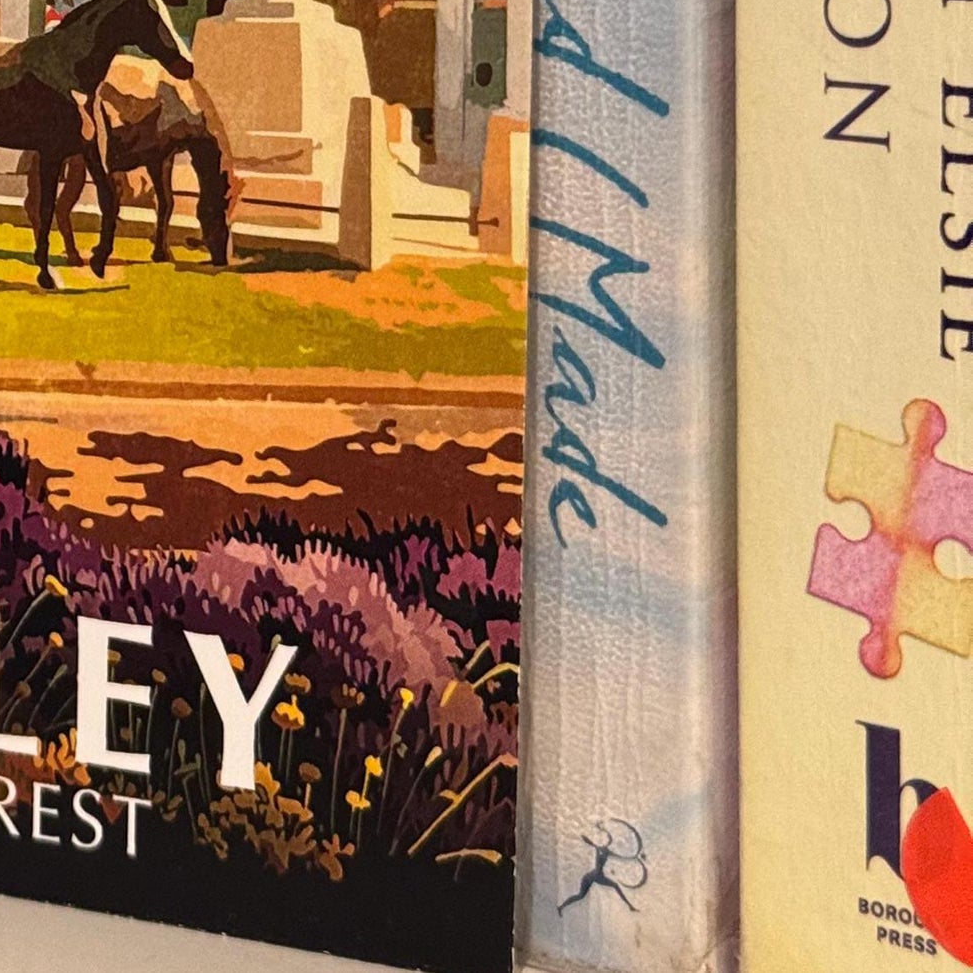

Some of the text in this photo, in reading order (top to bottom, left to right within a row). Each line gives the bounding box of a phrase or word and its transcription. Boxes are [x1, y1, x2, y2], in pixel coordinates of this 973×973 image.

[530, 128, 649, 208] I
[529, 215, 669, 549] Made
[877, 925, 938, 956] PRESS
